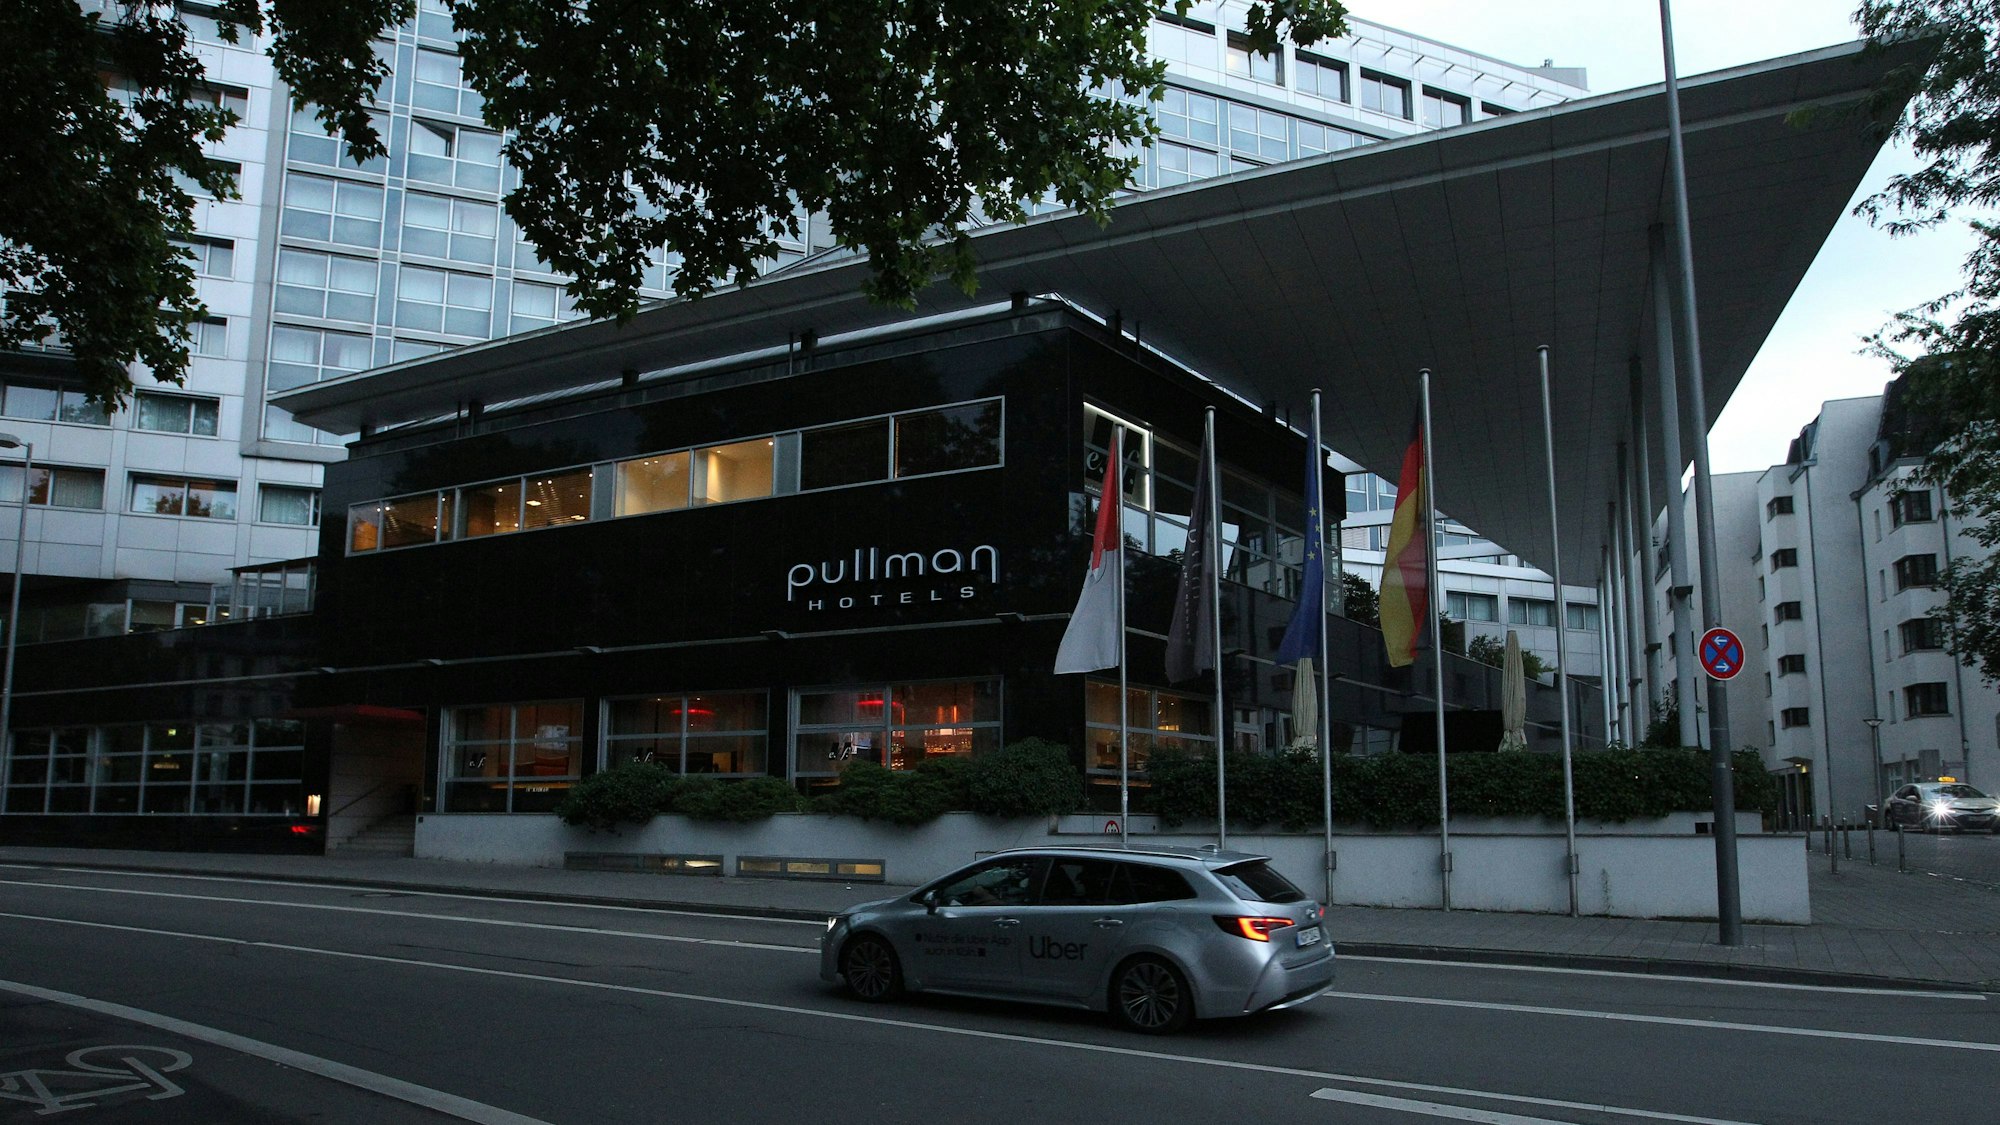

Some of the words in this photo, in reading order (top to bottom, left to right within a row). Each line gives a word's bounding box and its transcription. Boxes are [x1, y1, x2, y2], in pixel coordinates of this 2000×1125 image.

[787, 544, 998, 601] pullman
[808, 585, 975, 611] HOTELS
[1029, 935, 1089, 961] Uber
